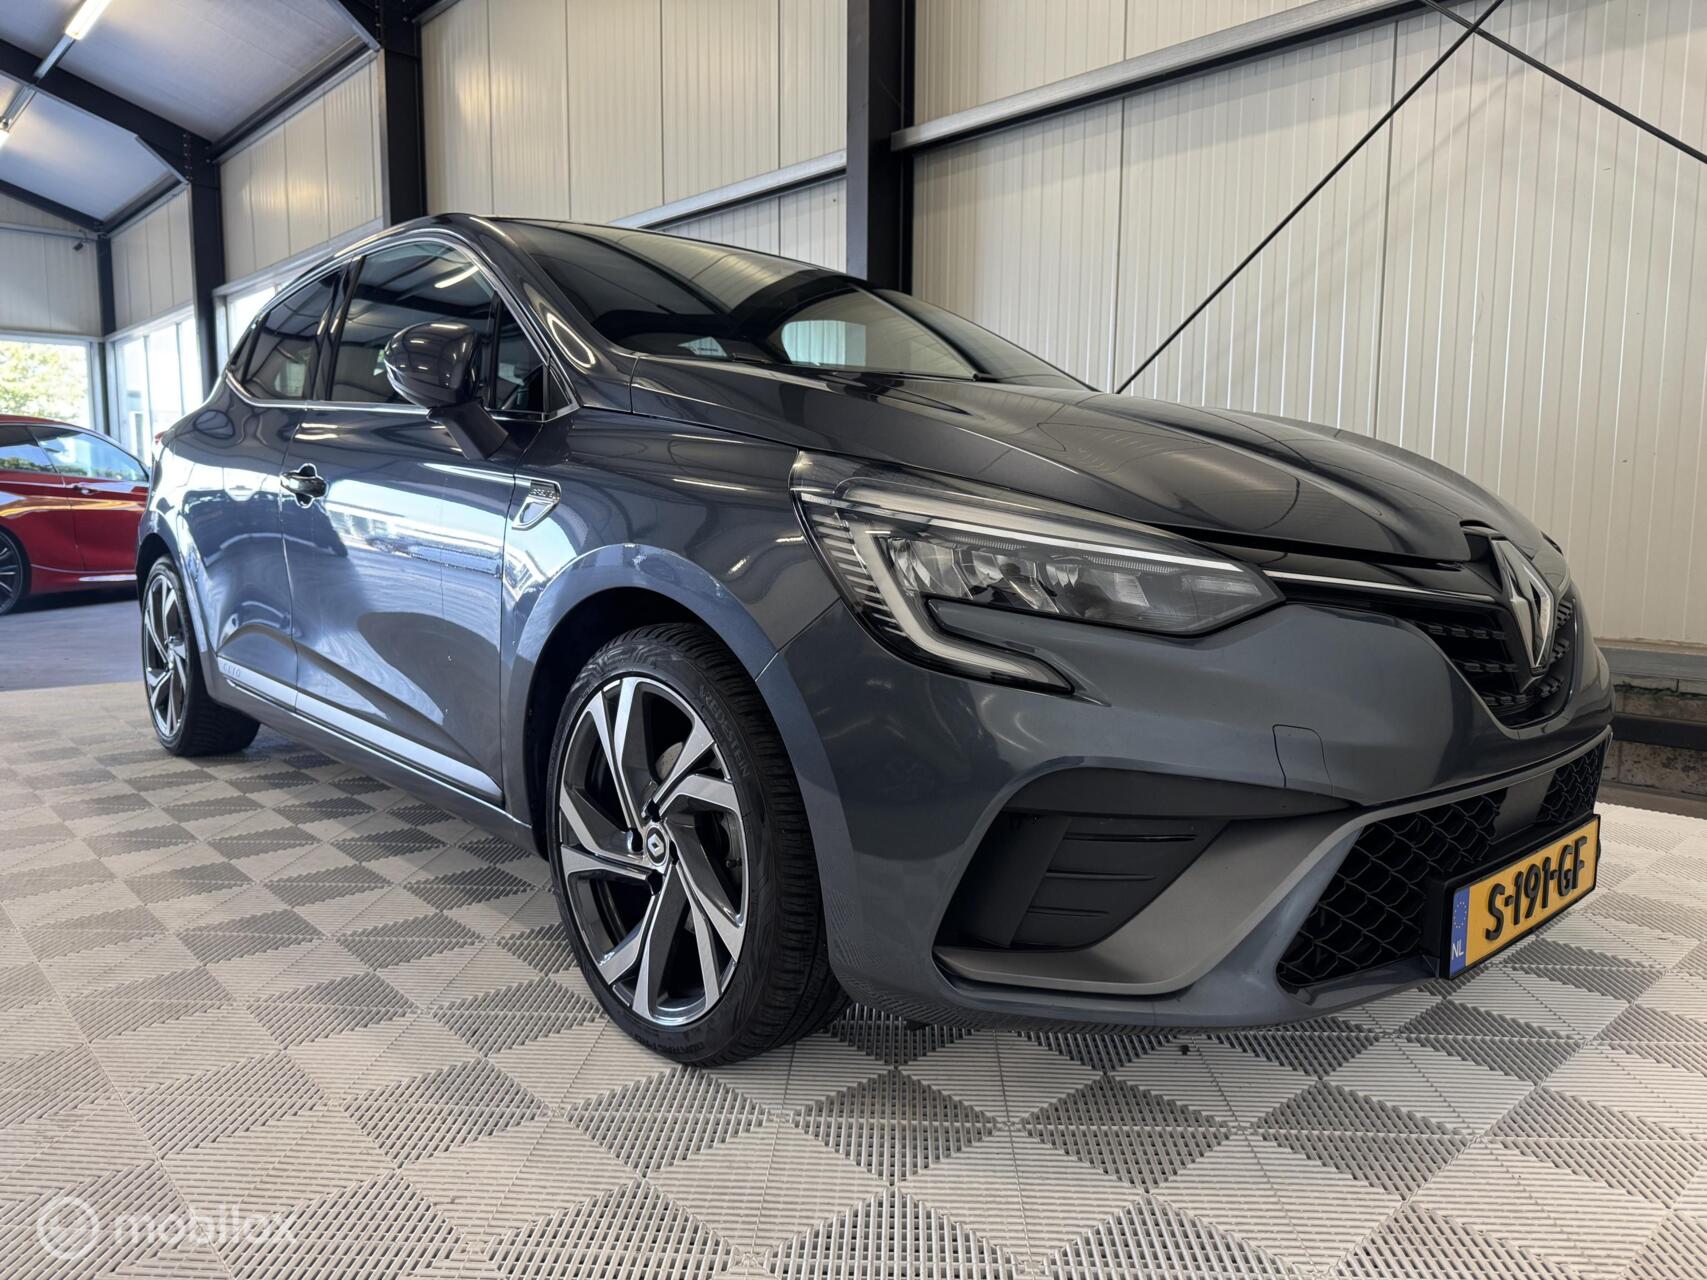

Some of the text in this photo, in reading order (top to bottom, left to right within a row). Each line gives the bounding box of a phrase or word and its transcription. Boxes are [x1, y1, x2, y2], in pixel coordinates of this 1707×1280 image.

[223, 662, 241, 677] CLIO
[1485, 836, 1588, 941] S-191-GF
[1451, 940, 1464, 960] NL
